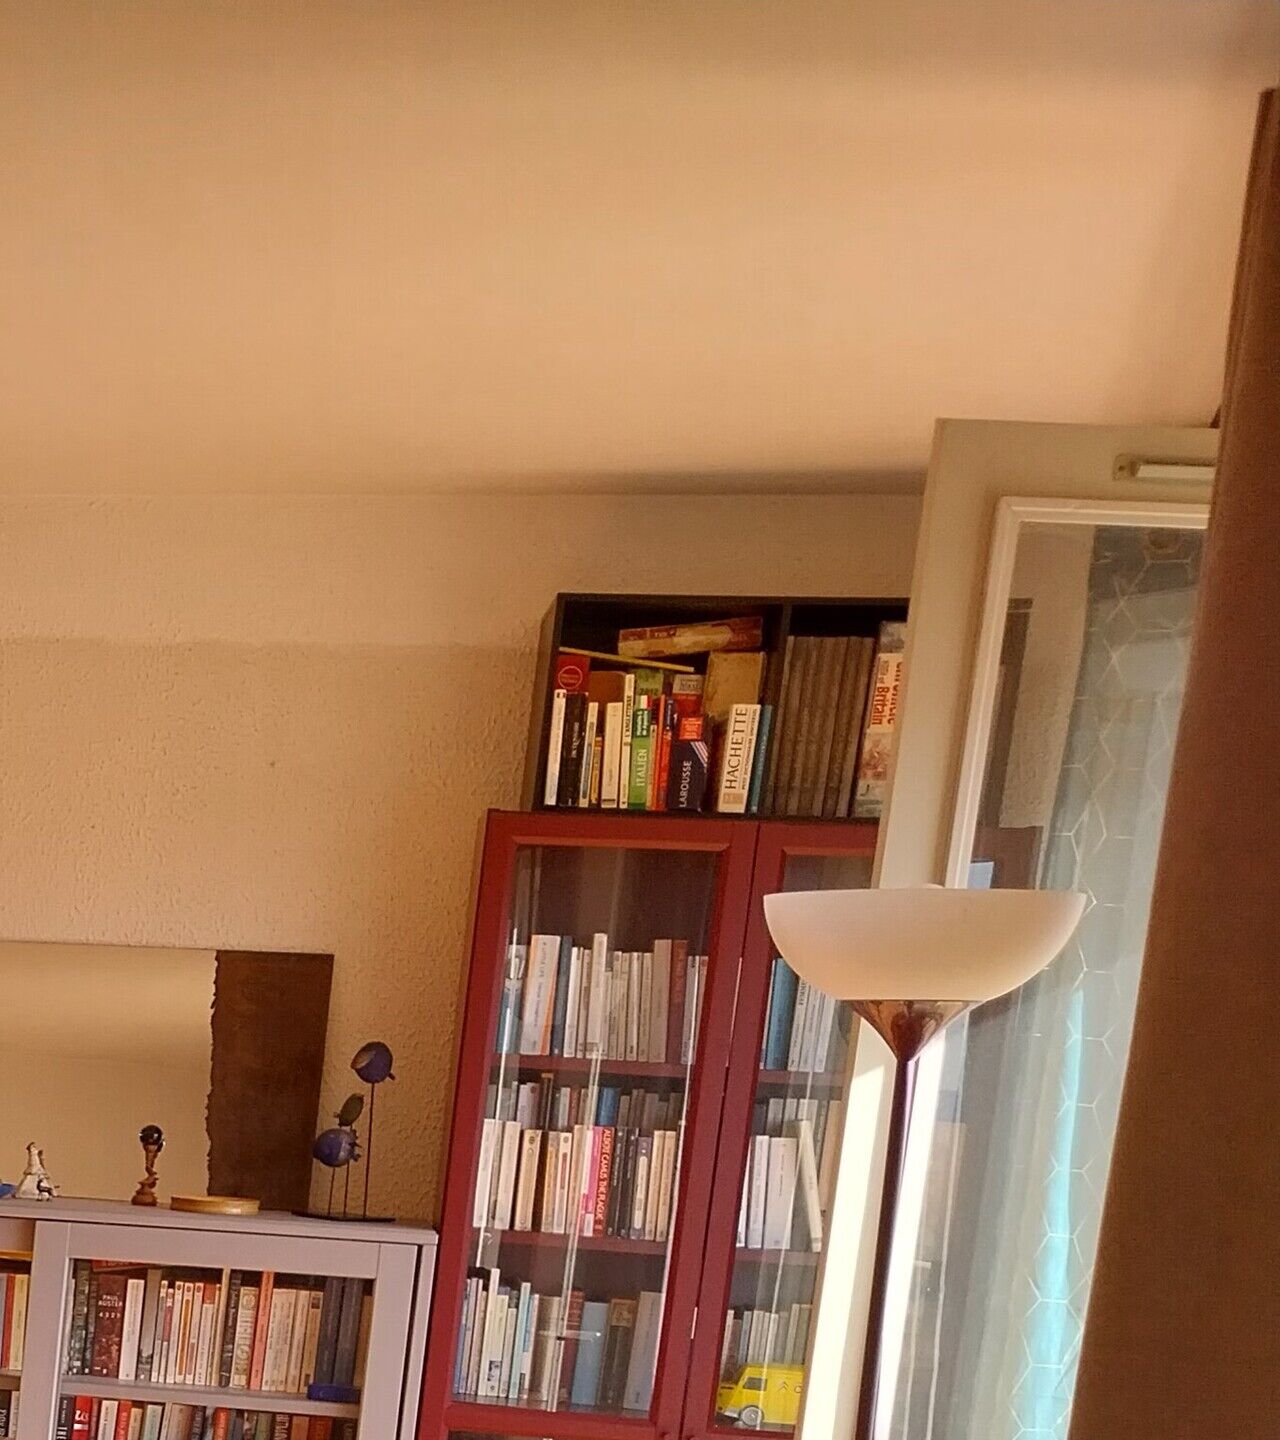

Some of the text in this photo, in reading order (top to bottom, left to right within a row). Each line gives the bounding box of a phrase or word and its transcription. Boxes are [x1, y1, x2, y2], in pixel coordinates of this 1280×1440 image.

[871, 687, 890, 726] Britain
[636, 748, 648, 787] ITALIEN
[724, 707, 749, 790] HACHETTE
[680, 760, 693, 808] LAROUSSE
[601, 1129, 611, 1153] ALBERT
[599, 1154, 609, 1179] CAMUS
[598, 1180, 607, 1194] THE
